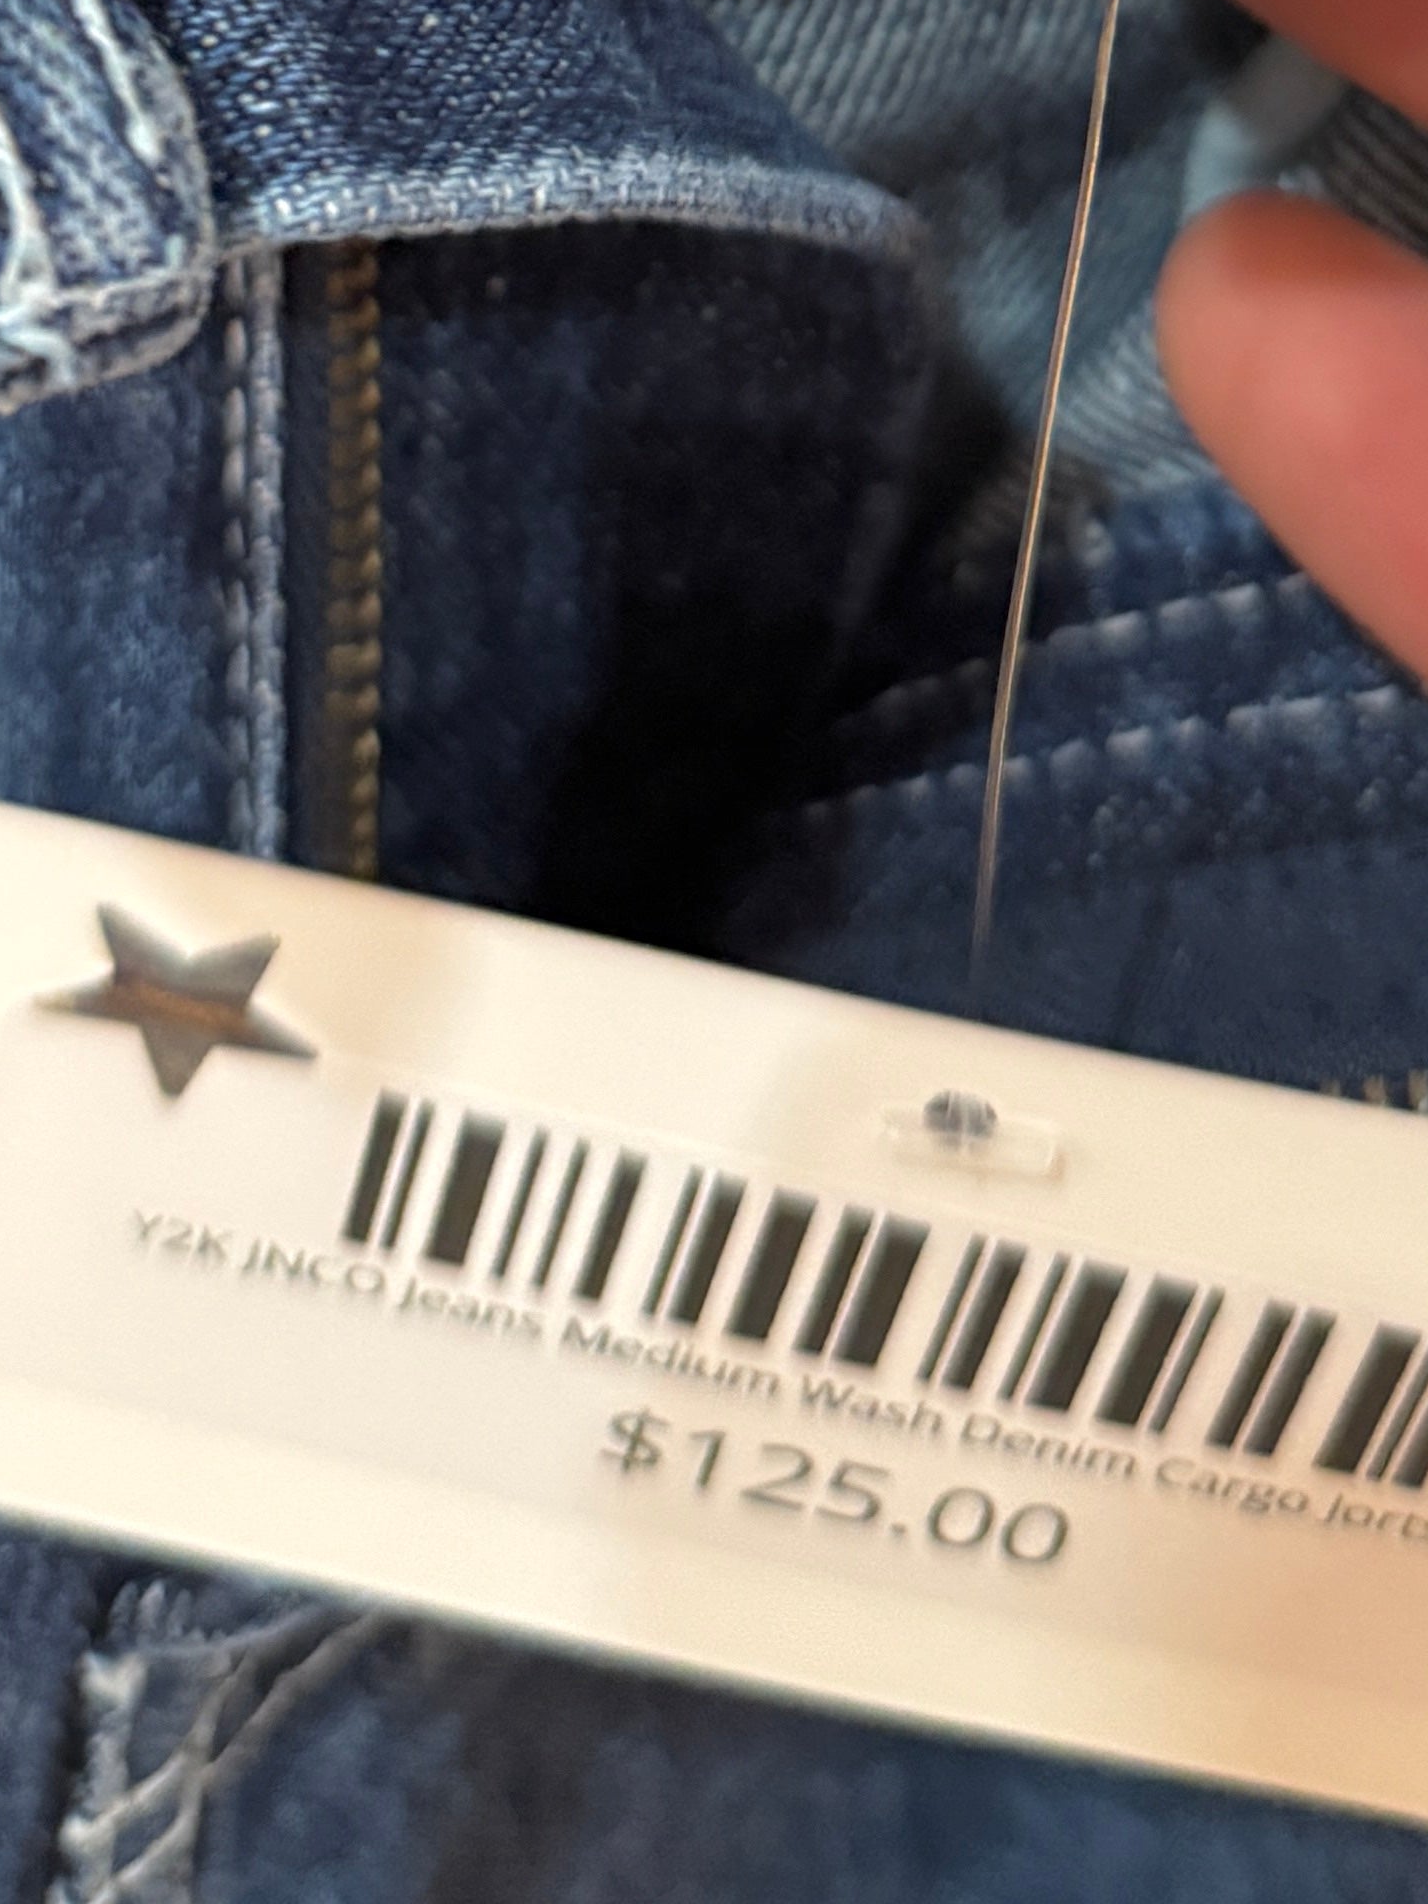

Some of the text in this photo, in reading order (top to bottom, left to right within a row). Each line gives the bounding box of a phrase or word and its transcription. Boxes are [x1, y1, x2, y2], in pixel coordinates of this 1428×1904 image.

[129, 1206, 228, 1261] Y2K
[241, 1239, 386, 1294] JNCO
[394, 1276, 544, 1340] Jeans
[561, 1311, 781, 1397] Medium
[800, 1376, 944, 1440] Wash
[960, 1412, 1141, 1482] Denim
[1154, 1455, 1310, 1517] Cargo
[600, 1404, 1071, 1568] $125.00
